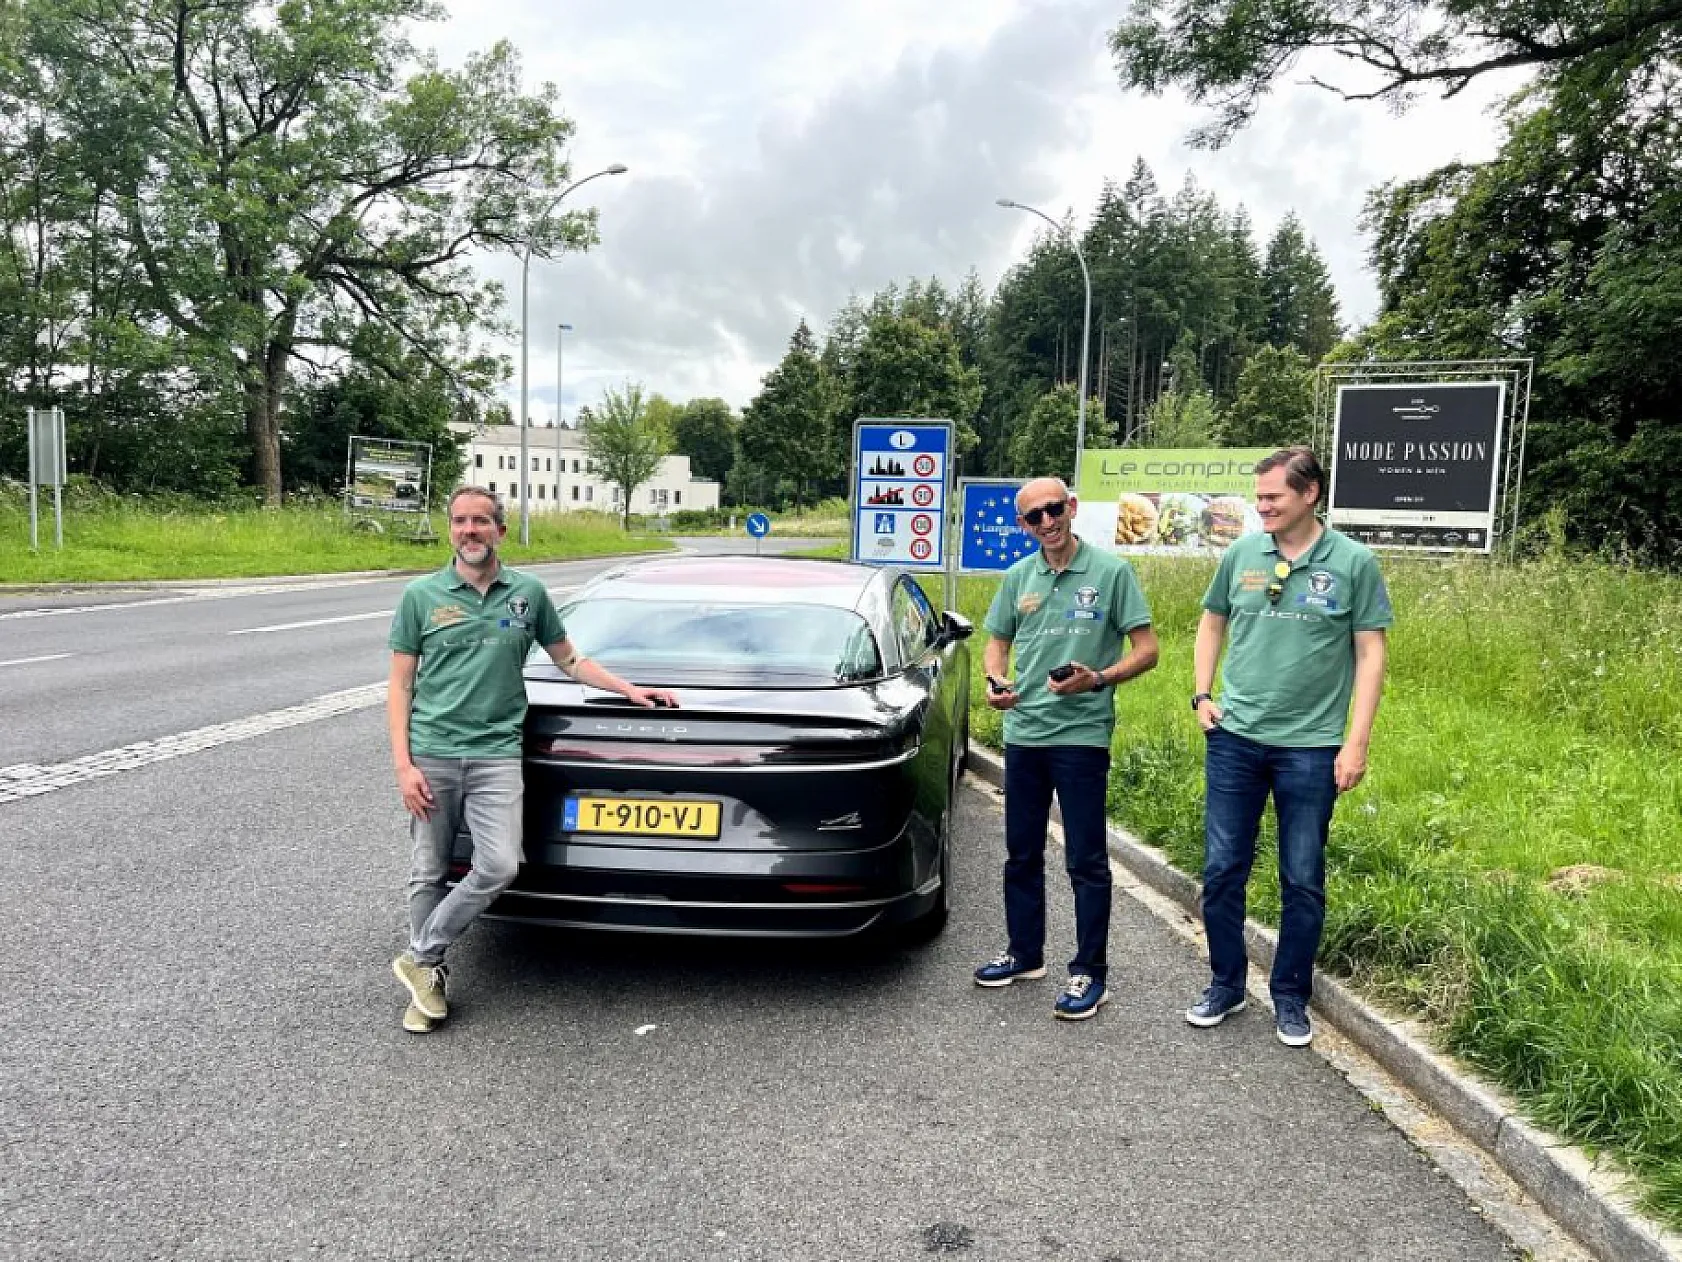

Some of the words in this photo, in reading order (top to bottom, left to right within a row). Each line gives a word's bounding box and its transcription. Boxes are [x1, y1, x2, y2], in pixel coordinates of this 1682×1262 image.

[1344, 441, 1396, 461] MODE
[1403, 441, 1487, 461] PASSION
[1101, 459, 1138, 475] Le
[595, 723, 688, 733] LUCID
[592, 803, 702, 831] T-910-VJ
